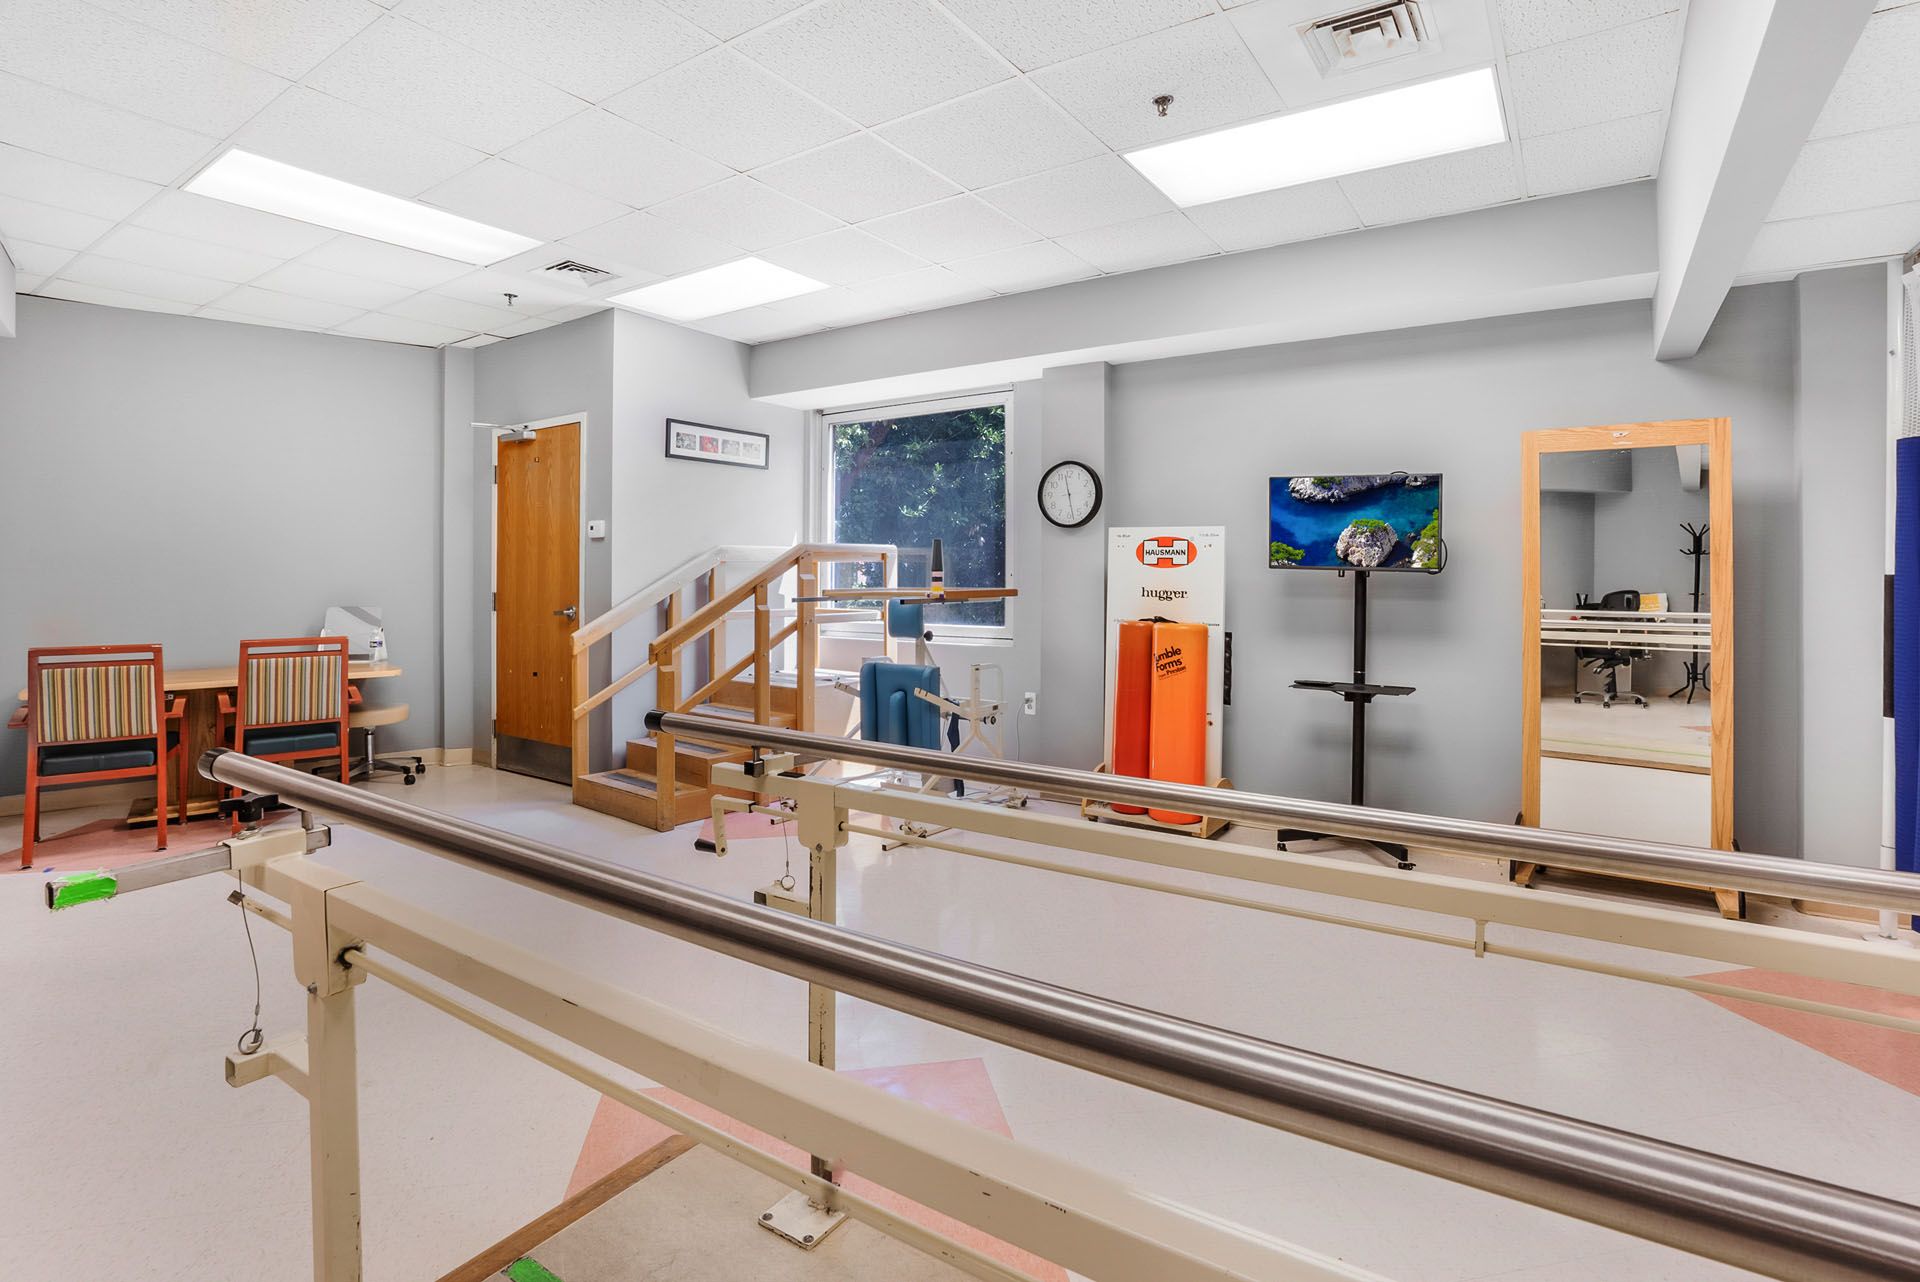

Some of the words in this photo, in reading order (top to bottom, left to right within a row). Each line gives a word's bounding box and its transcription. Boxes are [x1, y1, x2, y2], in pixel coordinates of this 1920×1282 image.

[1050, 481, 1059, 489] 10
[1047, 491, 1053, 499] 9
[1050, 502, 1056, 510] 8
[1141, 587, 1188, 601] hugger
[1154, 645, 1182, 663] umble
[1156, 658, 1183, 673] Forms
